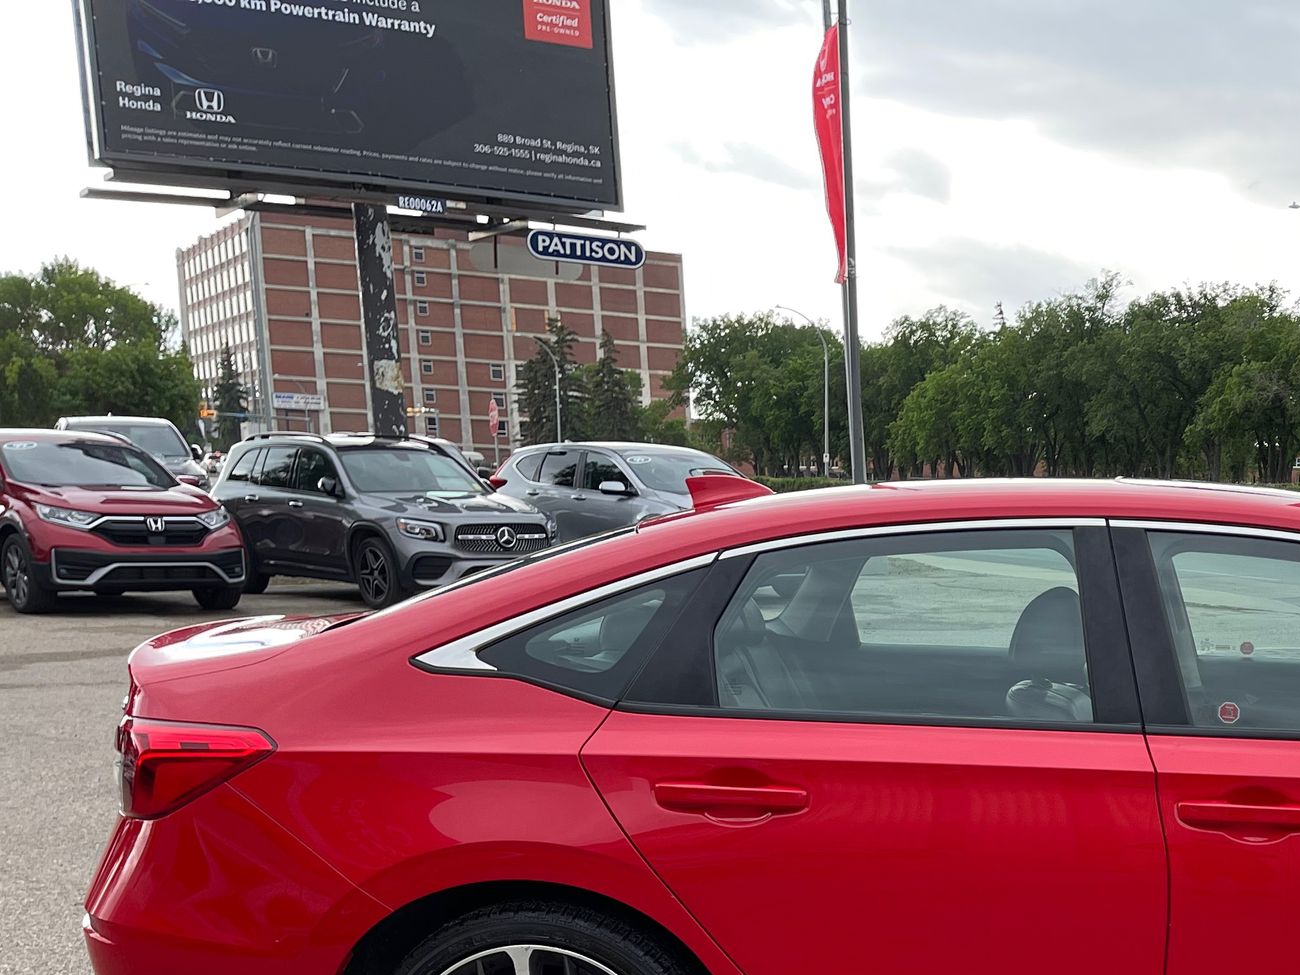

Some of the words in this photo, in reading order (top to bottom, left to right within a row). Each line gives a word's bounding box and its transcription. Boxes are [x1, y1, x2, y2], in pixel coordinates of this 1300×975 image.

[411, 0, 420, 12] a
[270, 0, 360, 24] Powertrain
[362, 12, 436, 38] Warranty
[536, 12, 579, 27] Certified
[116, 80, 161, 97] Regina
[118, 96, 162, 112] Honda
[186, 111, 237, 124] HONDA
[497, 133, 514, 144] 889
[515, 136, 541, 147] Broad
[556, 141, 588, 154] Regina,
[589, 145, 600, 154] SK
[473, 143, 530, 159] 306-525-1555
[537, 152, 601, 168] reginahonda.ca
[398, 195, 443, 213] RE00062A
[537, 234, 637, 263] PATTISON
